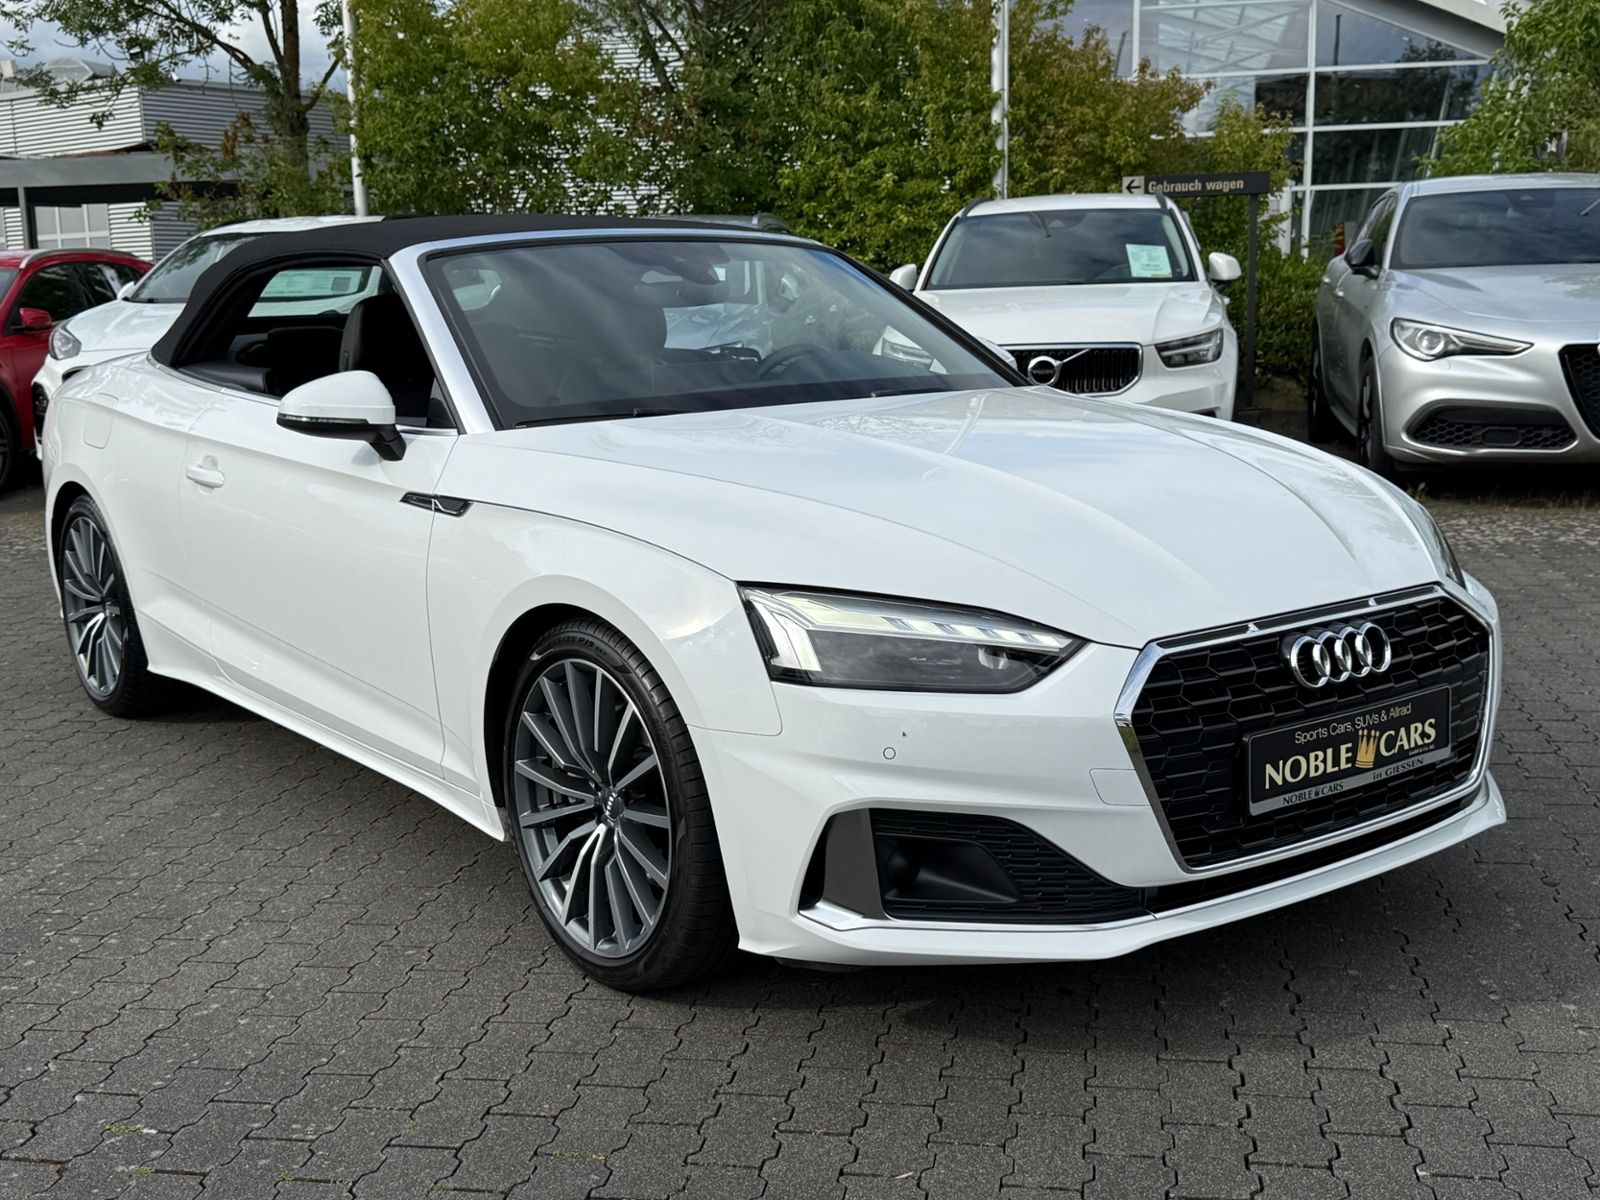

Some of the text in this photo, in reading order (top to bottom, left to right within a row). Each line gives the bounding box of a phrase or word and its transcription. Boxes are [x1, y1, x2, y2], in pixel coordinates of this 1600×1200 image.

[1205, 179, 1244, 193] wagen
[1294, 702, 1412, 745] Sports Cars, SUVs & Allrad
[1265, 718, 1436, 790] NOBLE CARS
[1372, 757, 1424, 780] in GIESSEN
[1282, 782, 1344, 805] NOBLE CARS
